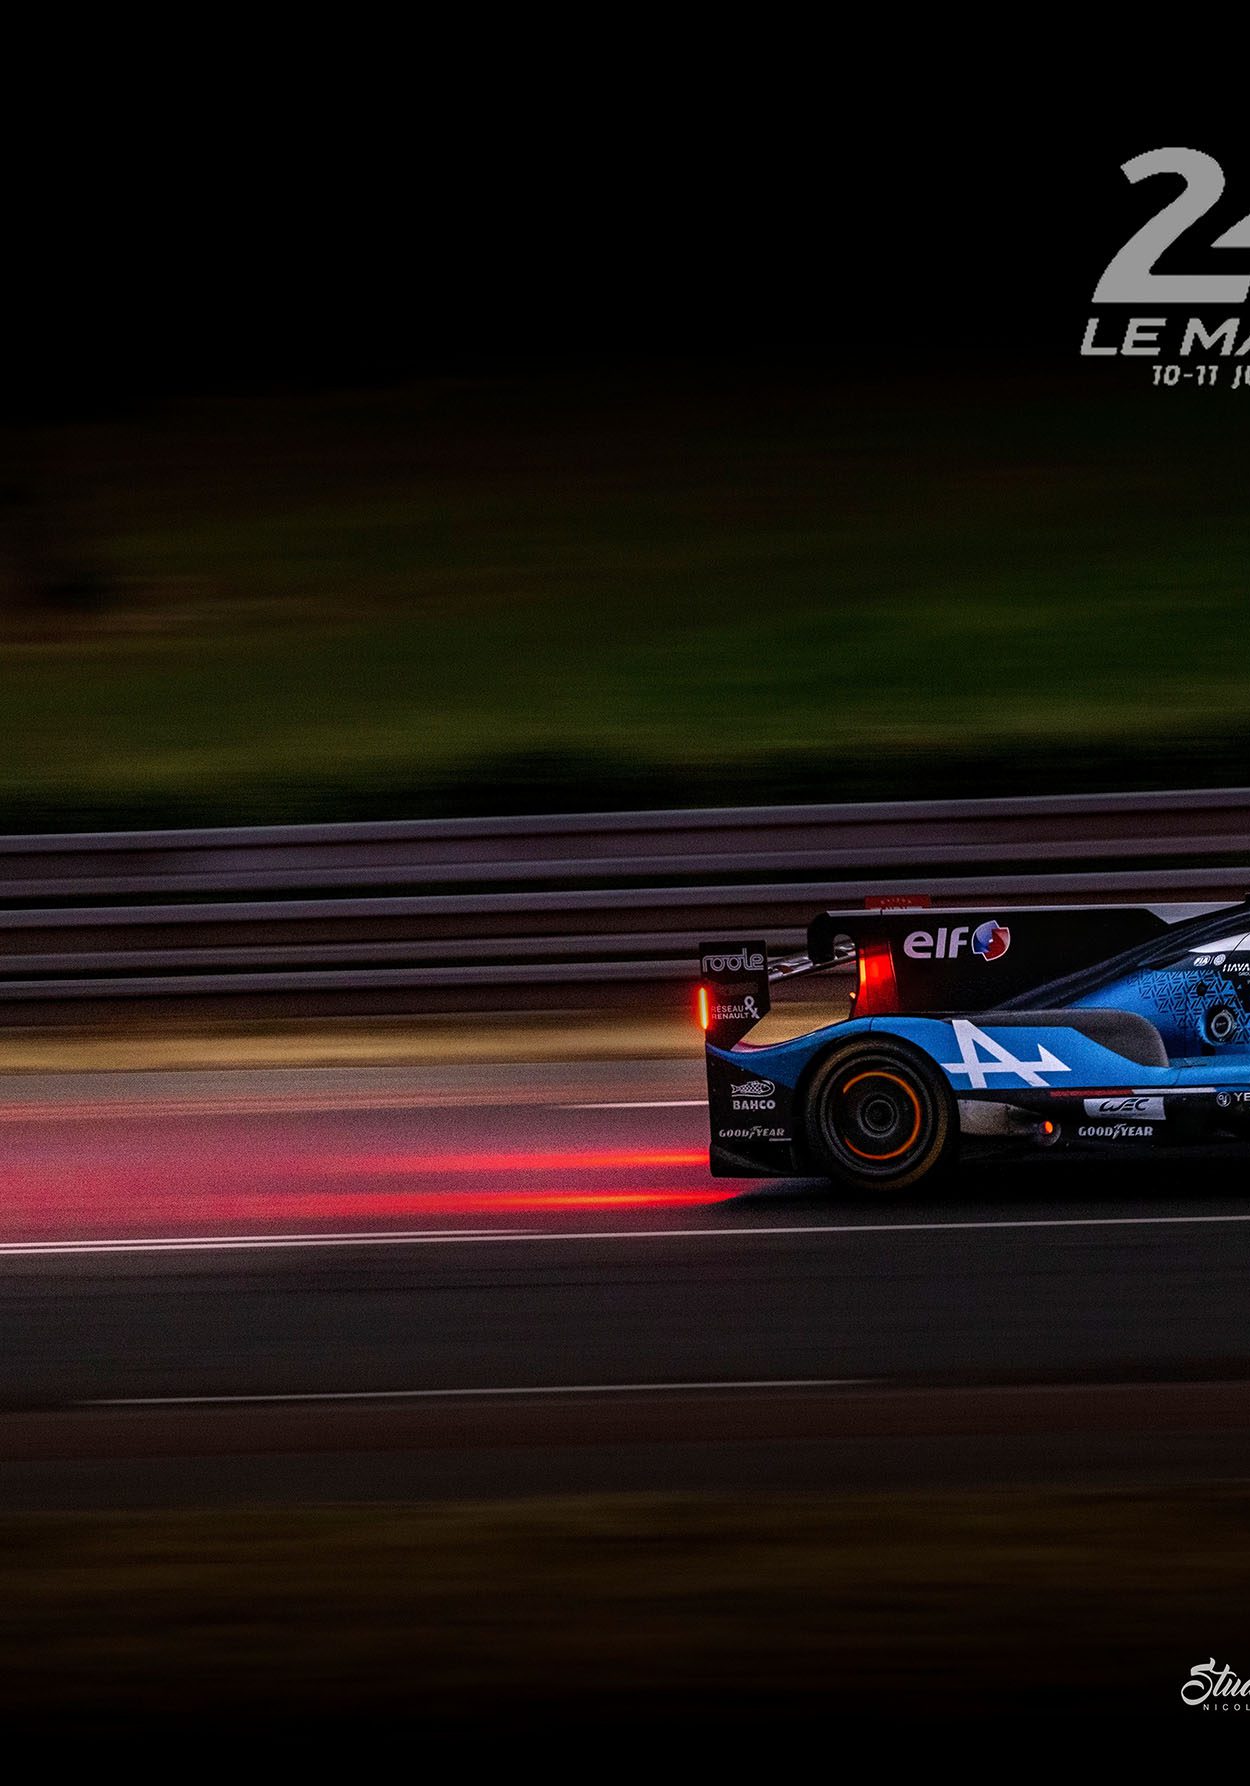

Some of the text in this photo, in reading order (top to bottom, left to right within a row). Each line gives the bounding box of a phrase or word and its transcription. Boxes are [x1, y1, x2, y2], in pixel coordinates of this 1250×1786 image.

[903, 926, 969, 959] elf
[702, 947, 764, 973] roole
[711, 1012, 749, 1020] RENAULT
[733, 1100, 776, 1110] BAHCO
[1100, 1098, 1149, 1112] WEC
[719, 1126, 785, 1139] GOODYEAR
[1078, 1124, 1154, 1139] GOODYEAR
